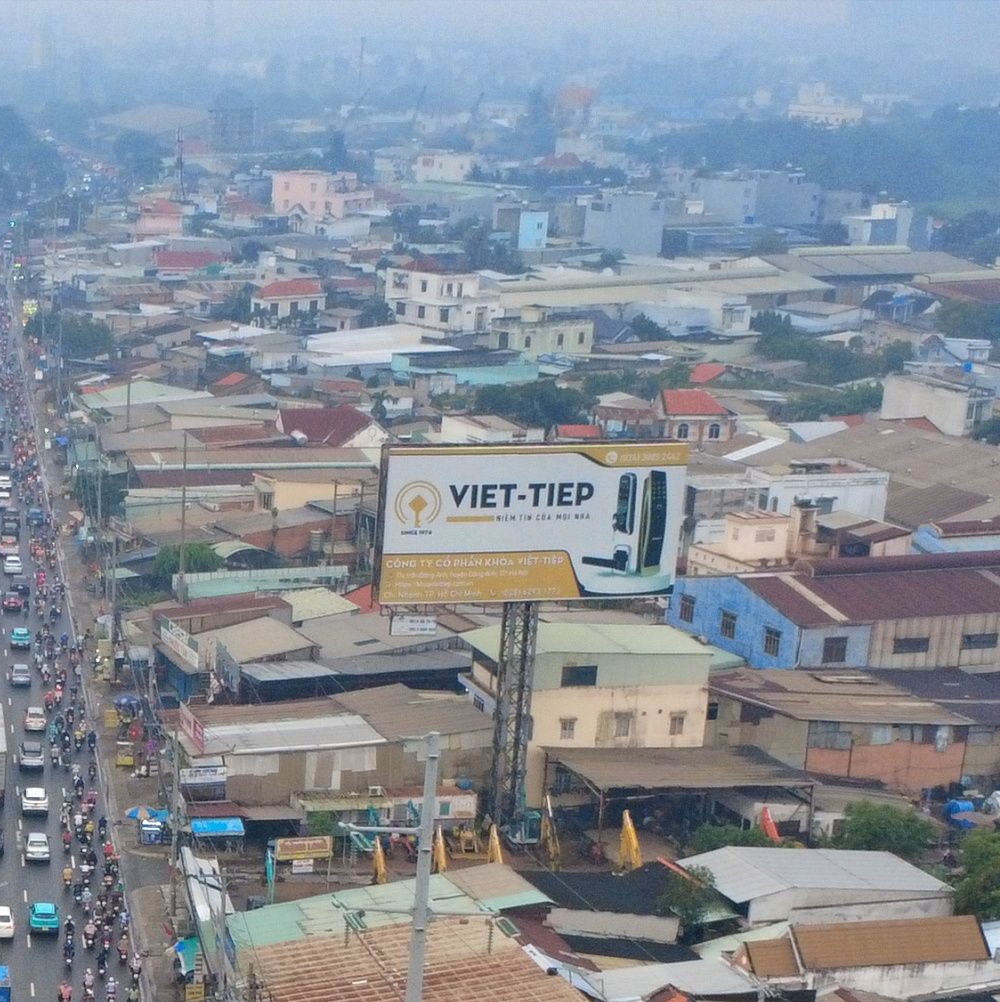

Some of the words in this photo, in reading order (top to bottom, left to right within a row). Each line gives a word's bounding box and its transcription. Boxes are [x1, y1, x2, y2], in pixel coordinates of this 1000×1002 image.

[449, 482, 594, 508] VIET-TIEP
[386, 557, 417, 569] CÔNG
[420, 559, 434, 568] TY
[435, 555, 451, 568] CỔ
